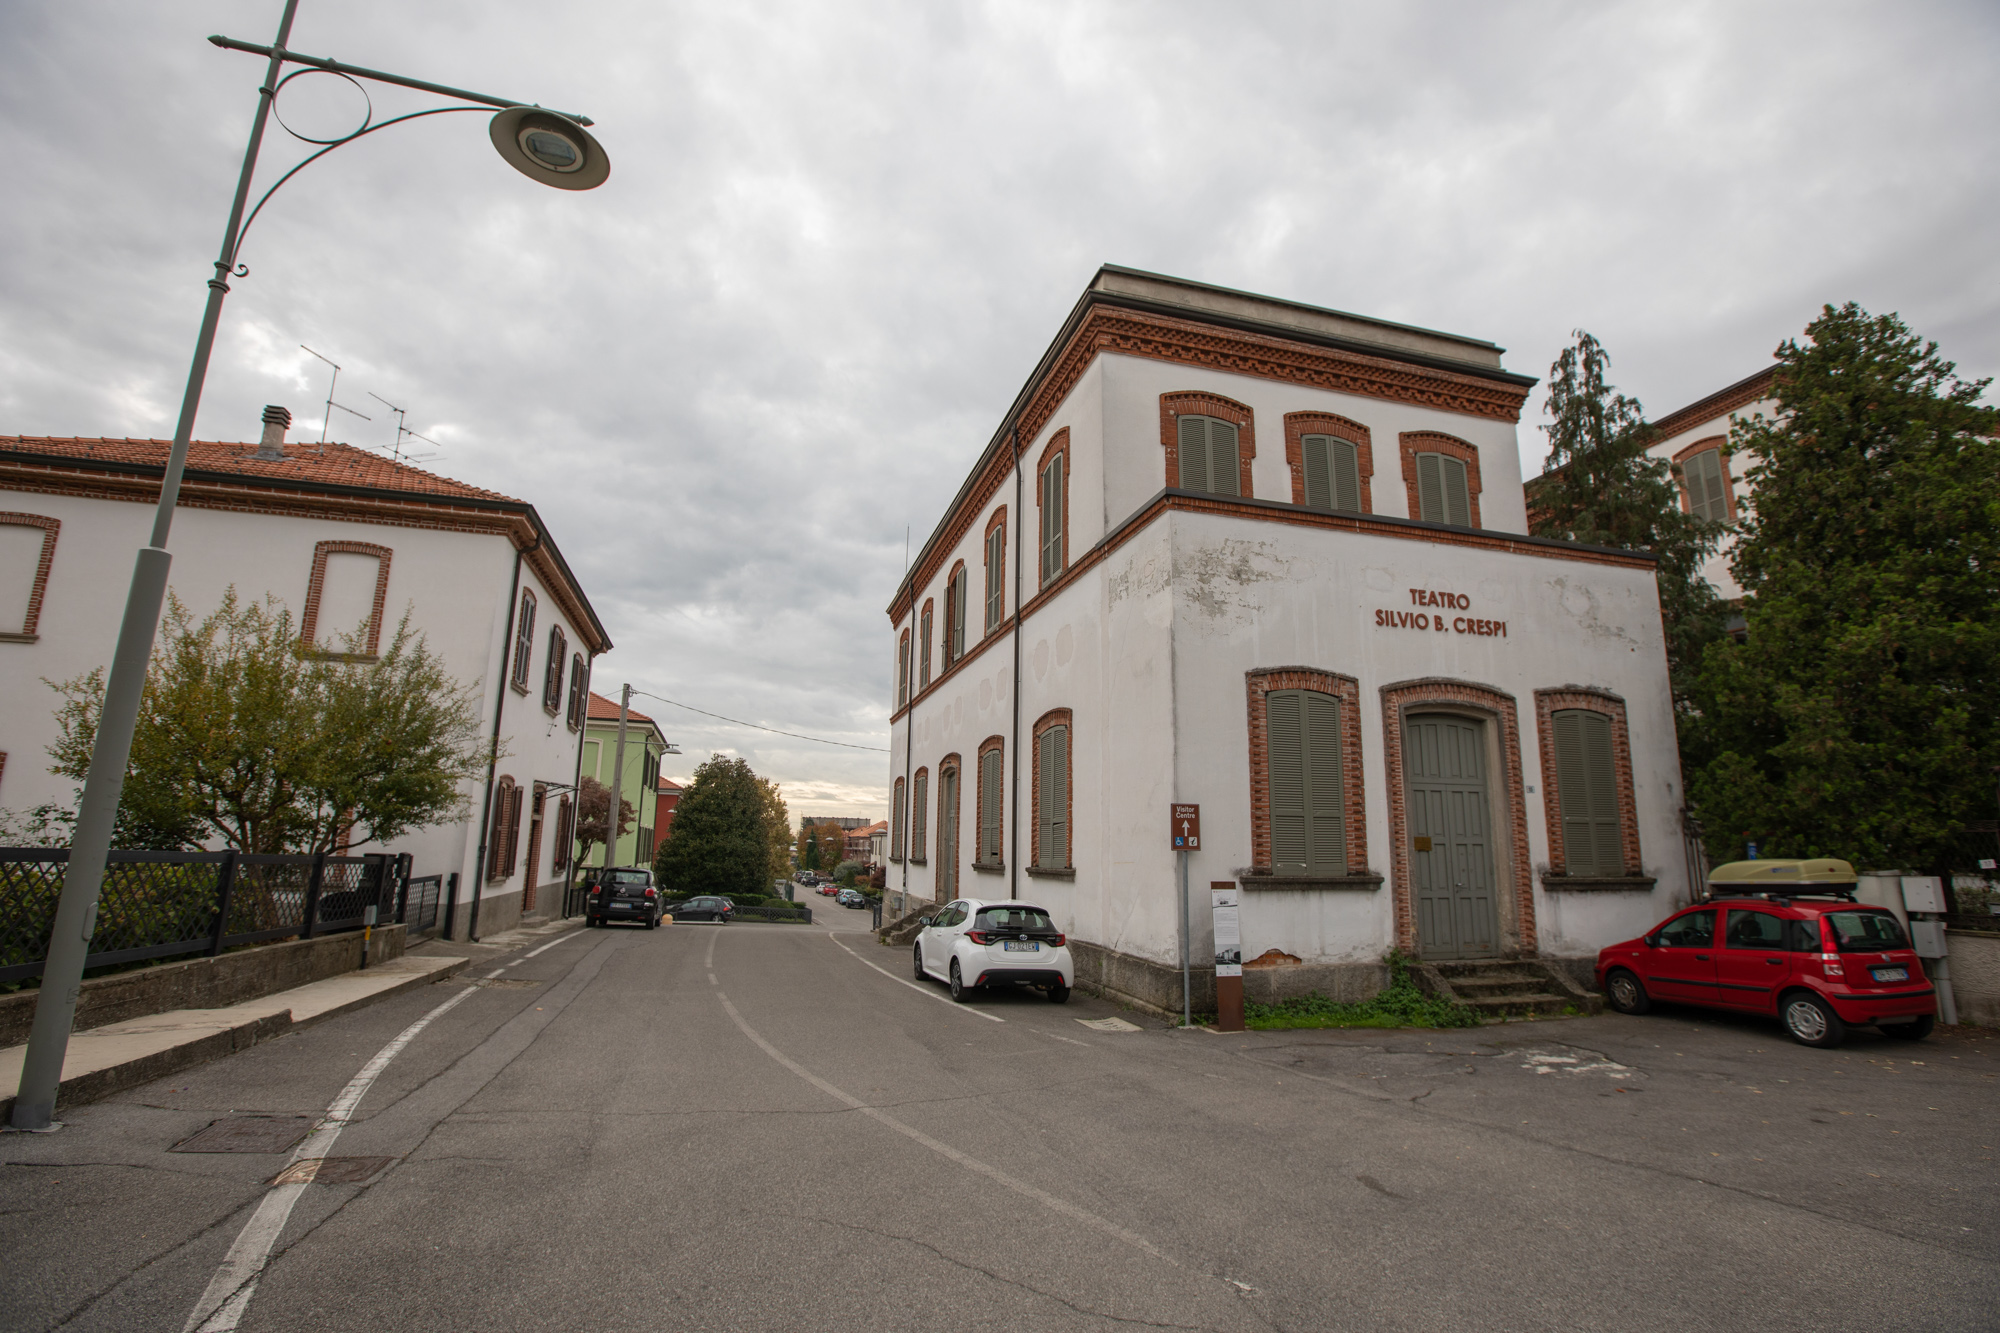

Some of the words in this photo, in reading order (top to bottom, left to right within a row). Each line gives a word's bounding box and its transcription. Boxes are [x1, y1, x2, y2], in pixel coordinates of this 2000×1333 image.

[1409, 588, 1470, 611] TEATRO
[1375, 609, 1429, 630] SILVIO
[1433, 615, 1449, 632] B.
[1453, 617, 1507, 638] CRESPI
